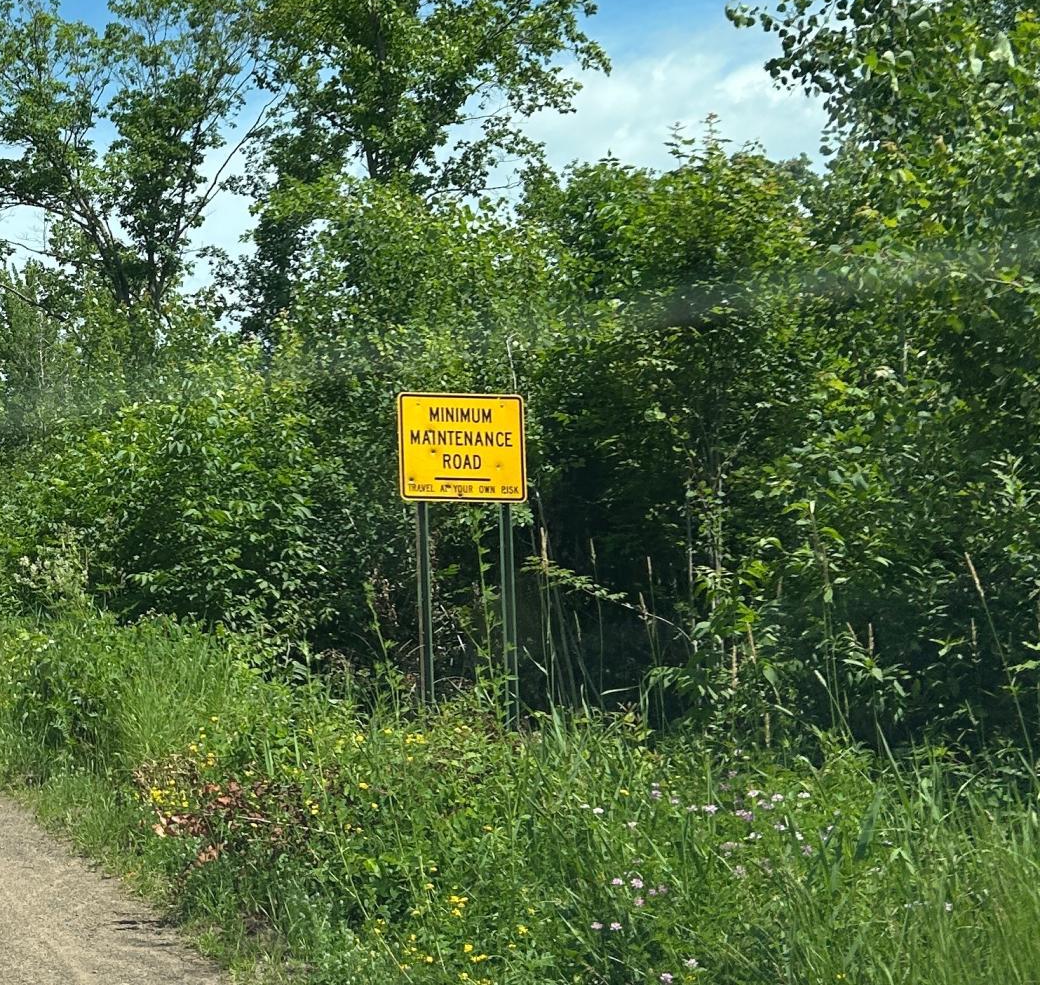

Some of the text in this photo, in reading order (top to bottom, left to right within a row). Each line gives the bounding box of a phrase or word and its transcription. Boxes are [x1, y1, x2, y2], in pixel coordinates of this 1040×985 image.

[429, 407, 492, 424] MINIMUM
[410, 429, 513, 447] MAINTENANCE
[443, 454, 482, 470] ROAD
[408, 483, 435, 493] TRAVEL
[453, 485, 473, 494] YOUR
[479, 485, 496, 494] OWN
[501, 486, 519, 495] RISK
